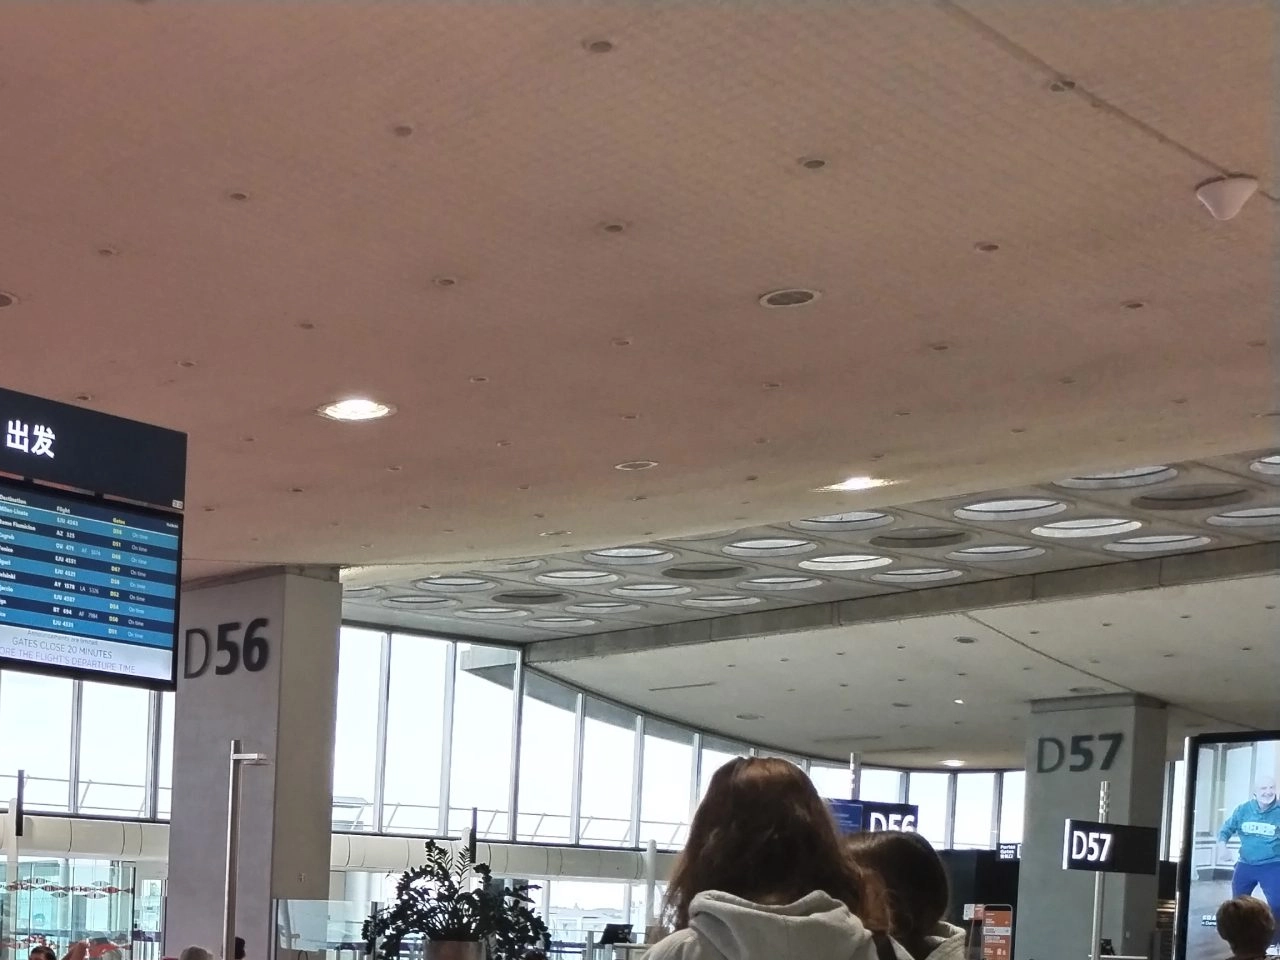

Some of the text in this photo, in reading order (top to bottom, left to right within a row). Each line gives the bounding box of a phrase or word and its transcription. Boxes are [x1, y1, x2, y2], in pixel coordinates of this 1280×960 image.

[6, 418, 56, 459] 出发
[12, 636, 37, 648] GATES
[39, 640, 64, 652] CLOSE
[67, 645, 76, 654] 20
[78, 646, 112, 659] MINUTES
[18, 649, 32, 659] THE
[35, 651, 69, 664] FLIGHT'S
[71, 656, 116, 670] DEPARTURE
[184, 617, 270, 680] D56
[1037, 732, 1124, 773] D57
[1071, 830, 1113, 862] D57
